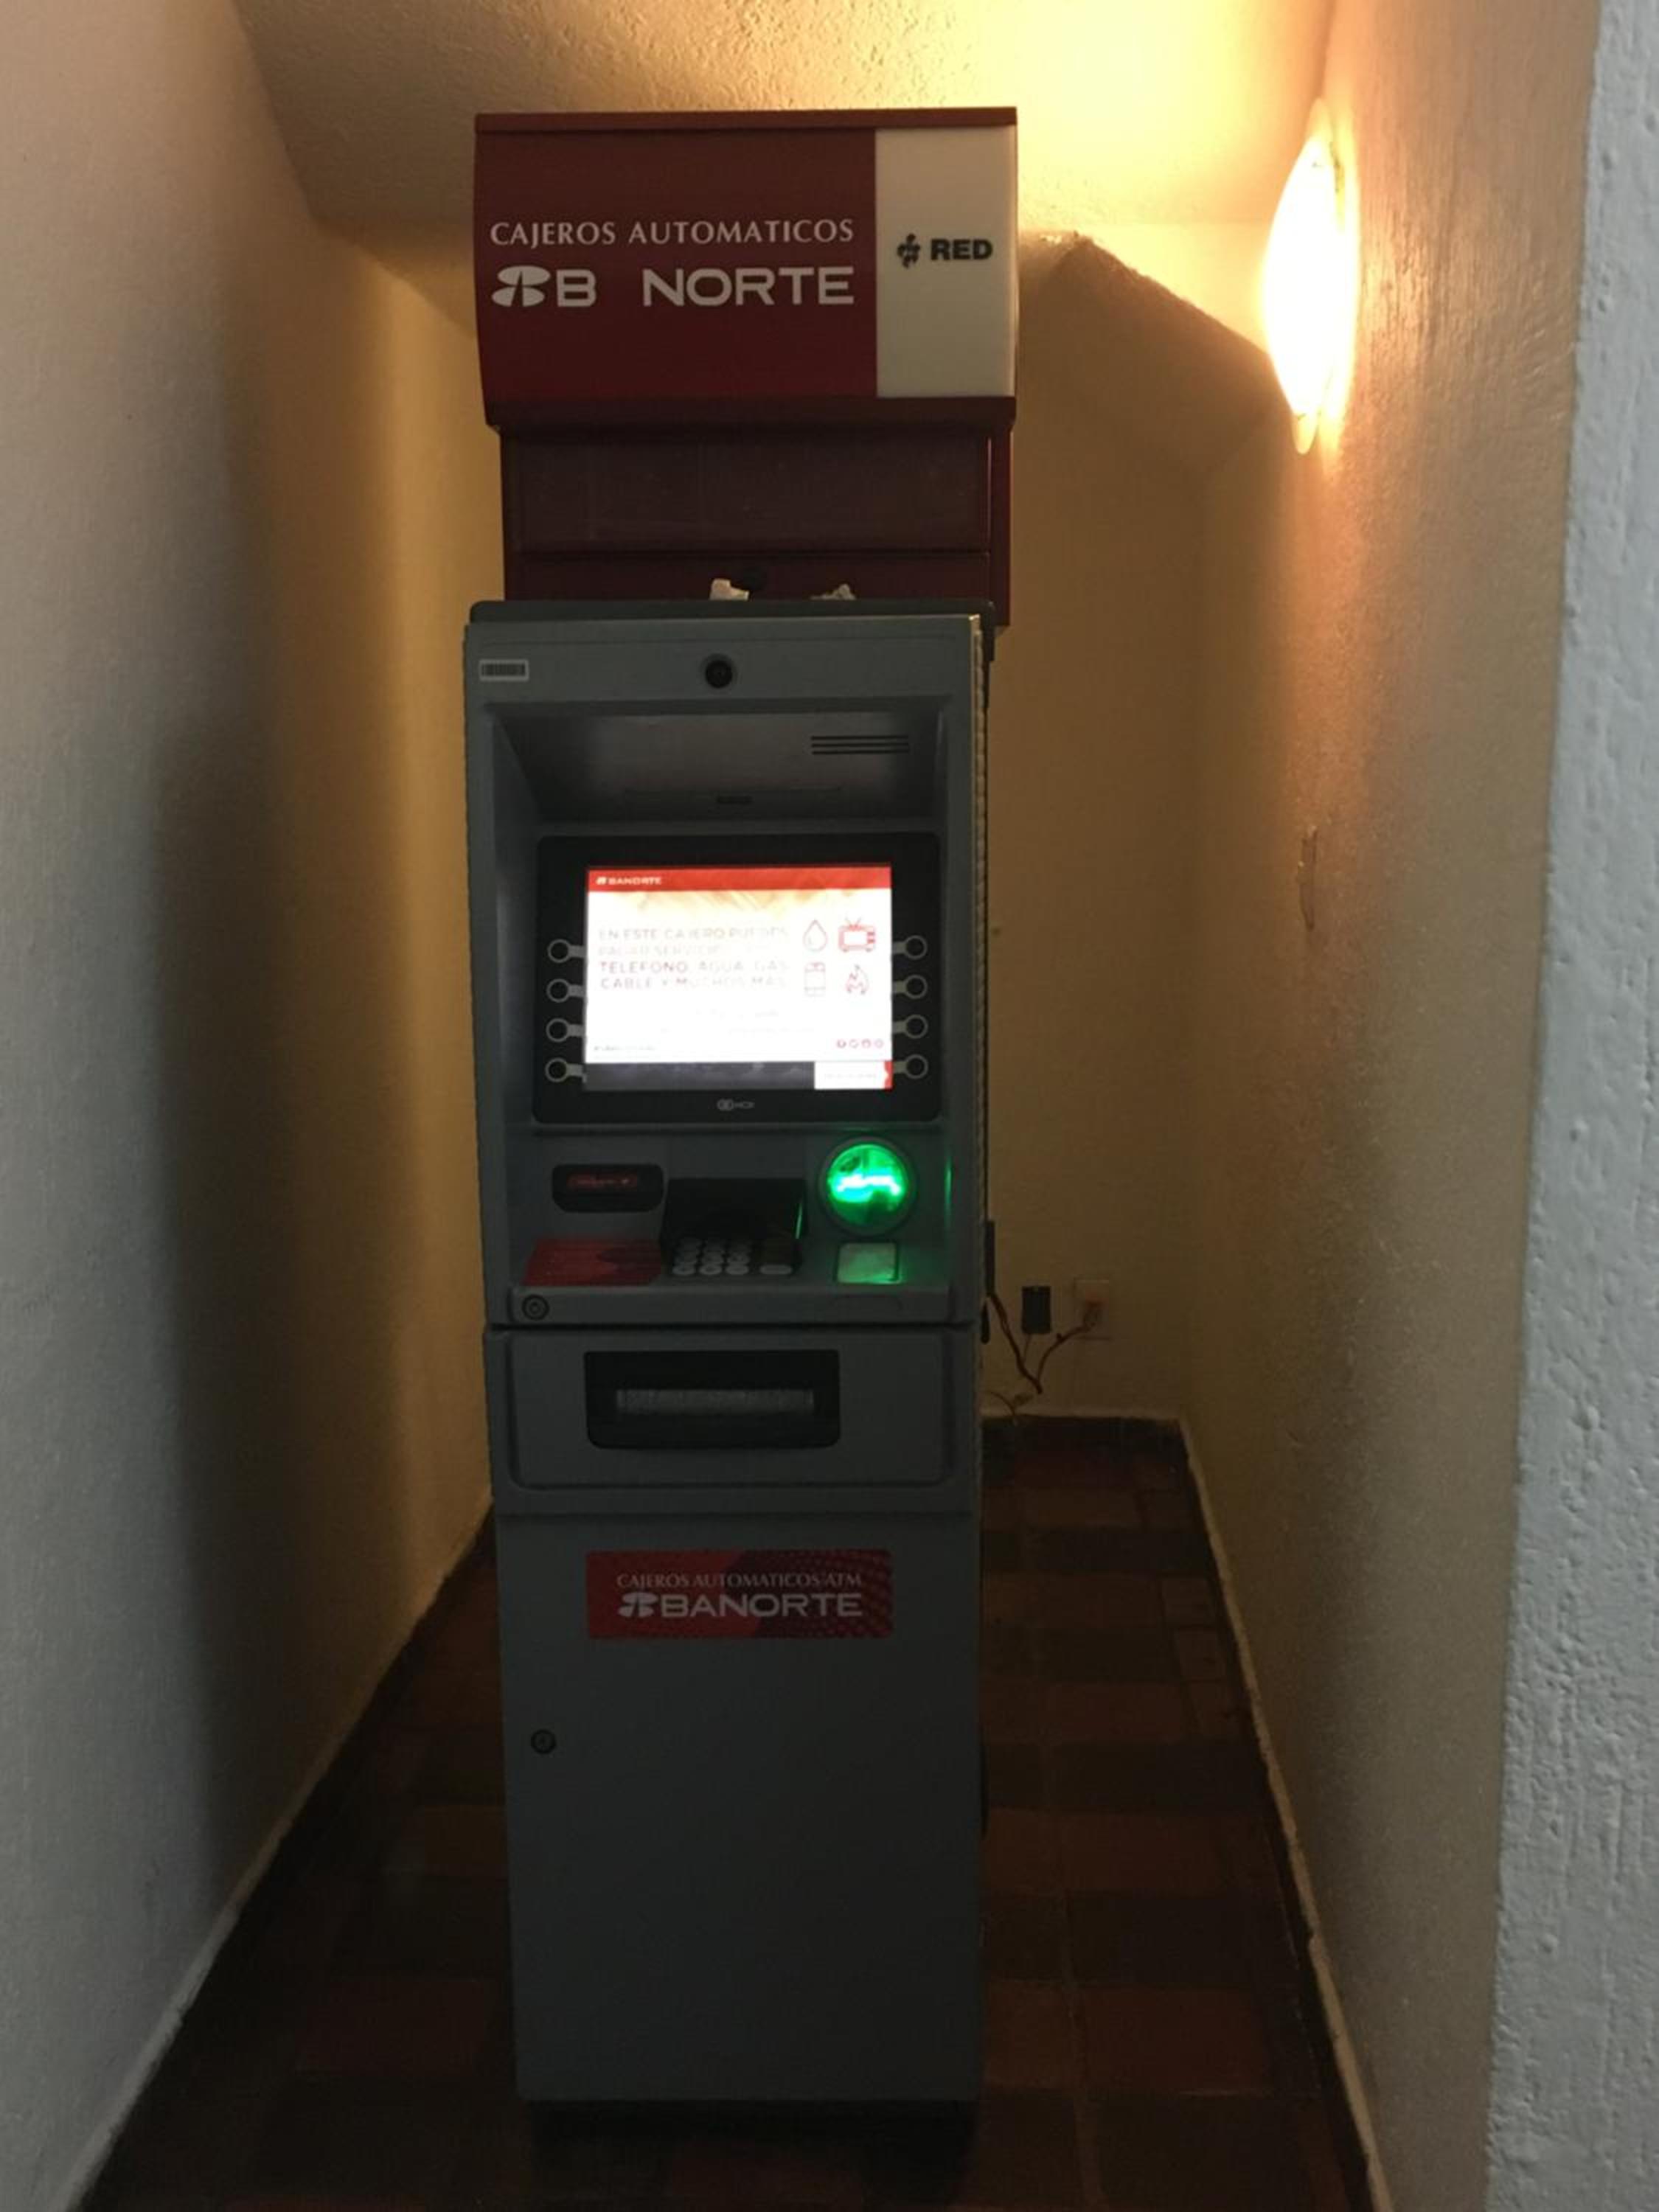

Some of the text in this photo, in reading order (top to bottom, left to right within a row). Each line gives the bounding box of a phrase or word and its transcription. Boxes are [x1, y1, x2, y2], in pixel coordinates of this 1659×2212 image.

[490, 218, 854, 248] CAJEROS AUTOMATICOS
[931, 238, 993, 261] RED
[642, 266, 855, 307] NORTE
[623, 928, 658, 940] ESTE
[616, 1571, 862, 1590] CAJEROS AUTOMATICOS ATM
[661, 1592, 863, 1618] BANORTE
